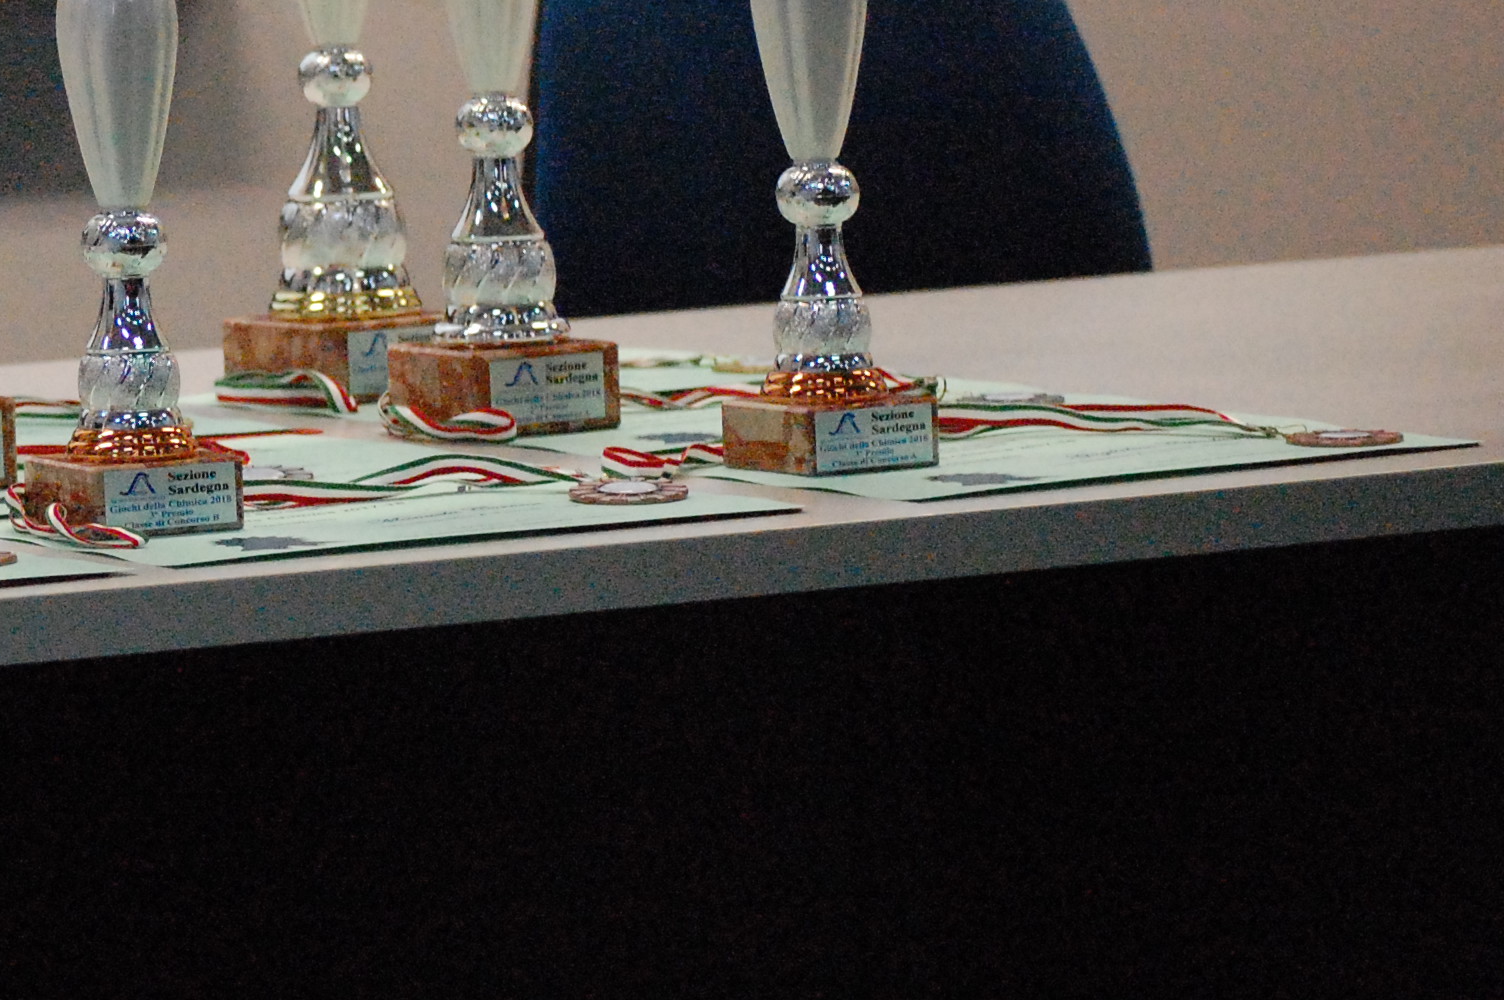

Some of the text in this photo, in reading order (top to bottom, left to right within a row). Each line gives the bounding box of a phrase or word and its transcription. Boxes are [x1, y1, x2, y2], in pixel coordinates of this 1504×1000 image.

[545, 361, 587, 372] Sezione
[545, 372, 598, 385] Sardegna
[871, 410, 914, 422] Sezione
[871, 421, 926, 435] Sardegna
[168, 469, 216, 482] Sezione
[168, 482, 229, 495] Sardegna
[109, 504, 141, 514] Giochi
[168, 498, 207, 508] Chimica
[161, 509, 194, 518] Premio
